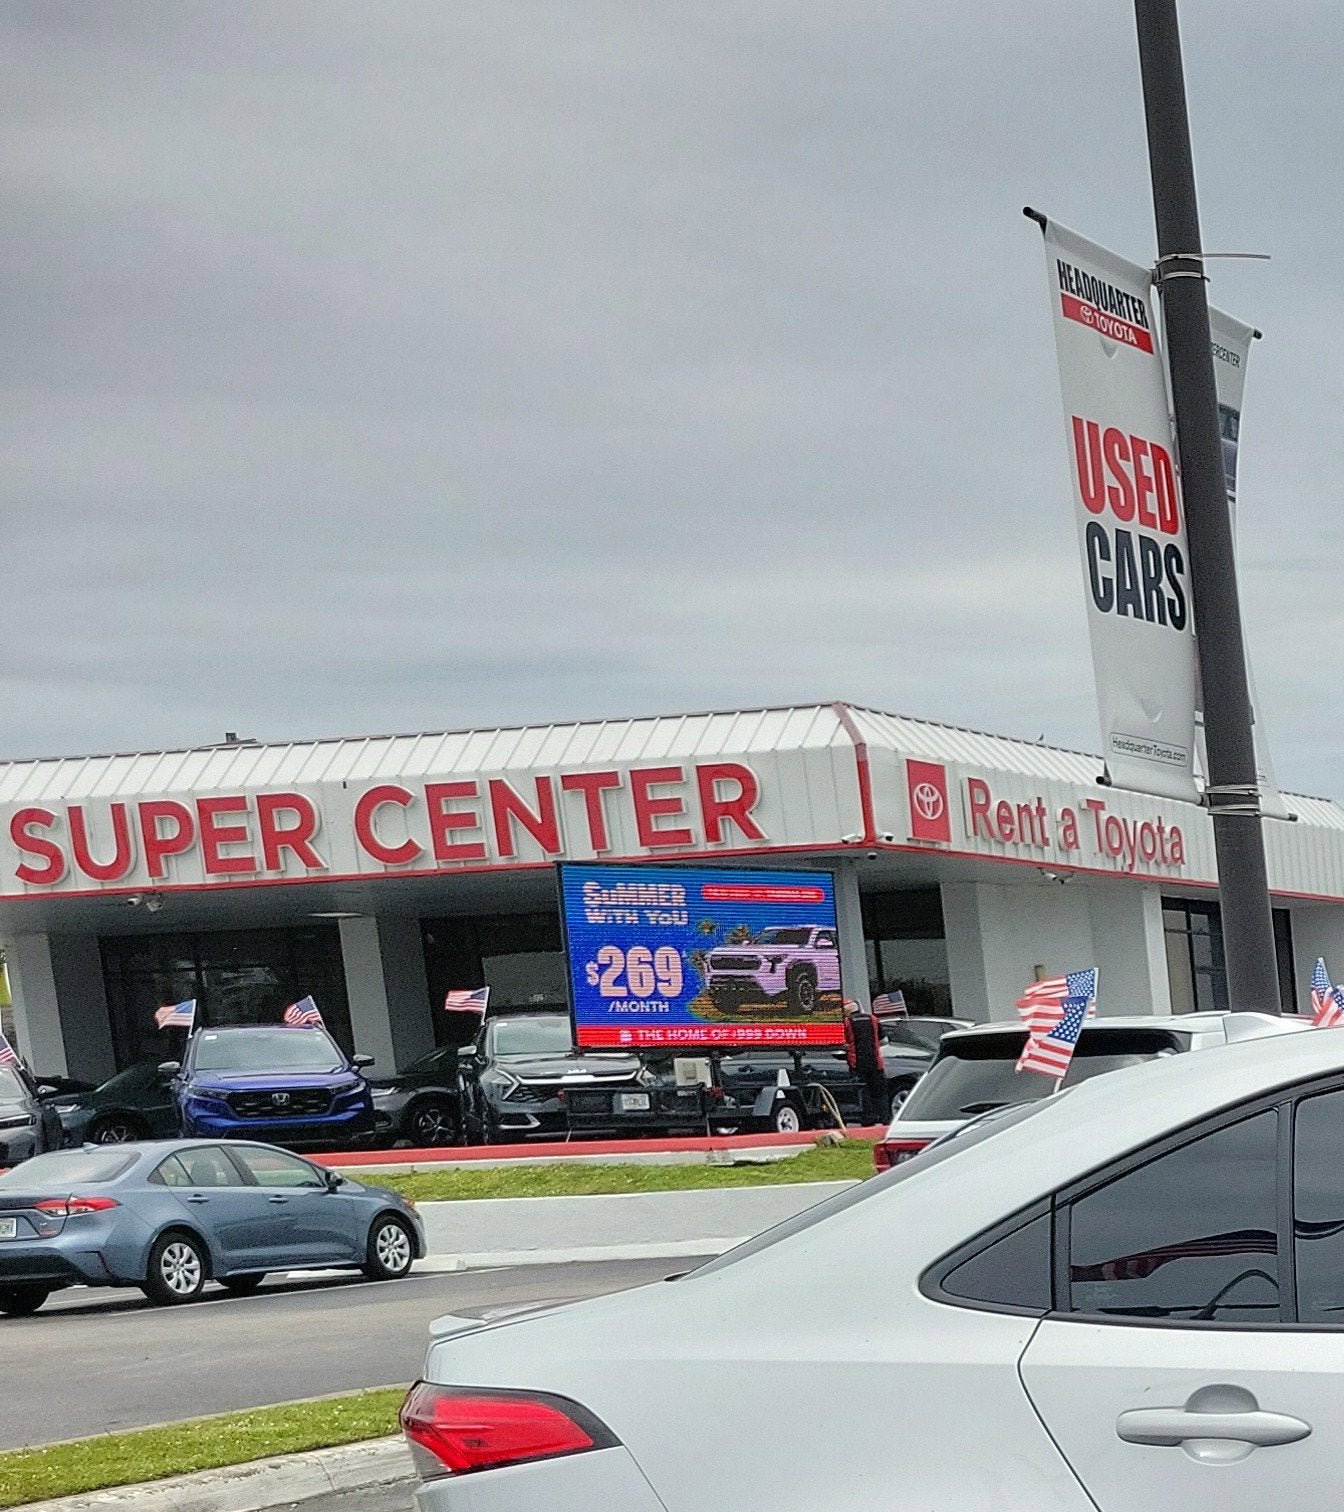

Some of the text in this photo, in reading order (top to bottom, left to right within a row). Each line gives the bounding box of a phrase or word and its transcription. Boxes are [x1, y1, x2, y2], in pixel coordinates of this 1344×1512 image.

[1056, 258, 1150, 330] HEADQUARTER
[1093, 311, 1138, 346] TOYOTA
[1072, 415, 1180, 536] USED
[1085, 520, 1187, 632] CARS
[1112, 736, 1187, 764] HeadquarterToyota.com
[10, 762, 769, 885] SUPER CENTER
[966, 776, 1187, 874] Rent a Toyota
[608, 1000, 670, 1013] /MONTH
[637, 1029, 664, 1041] THE
[667, 1029, 709, 1041] HOME
